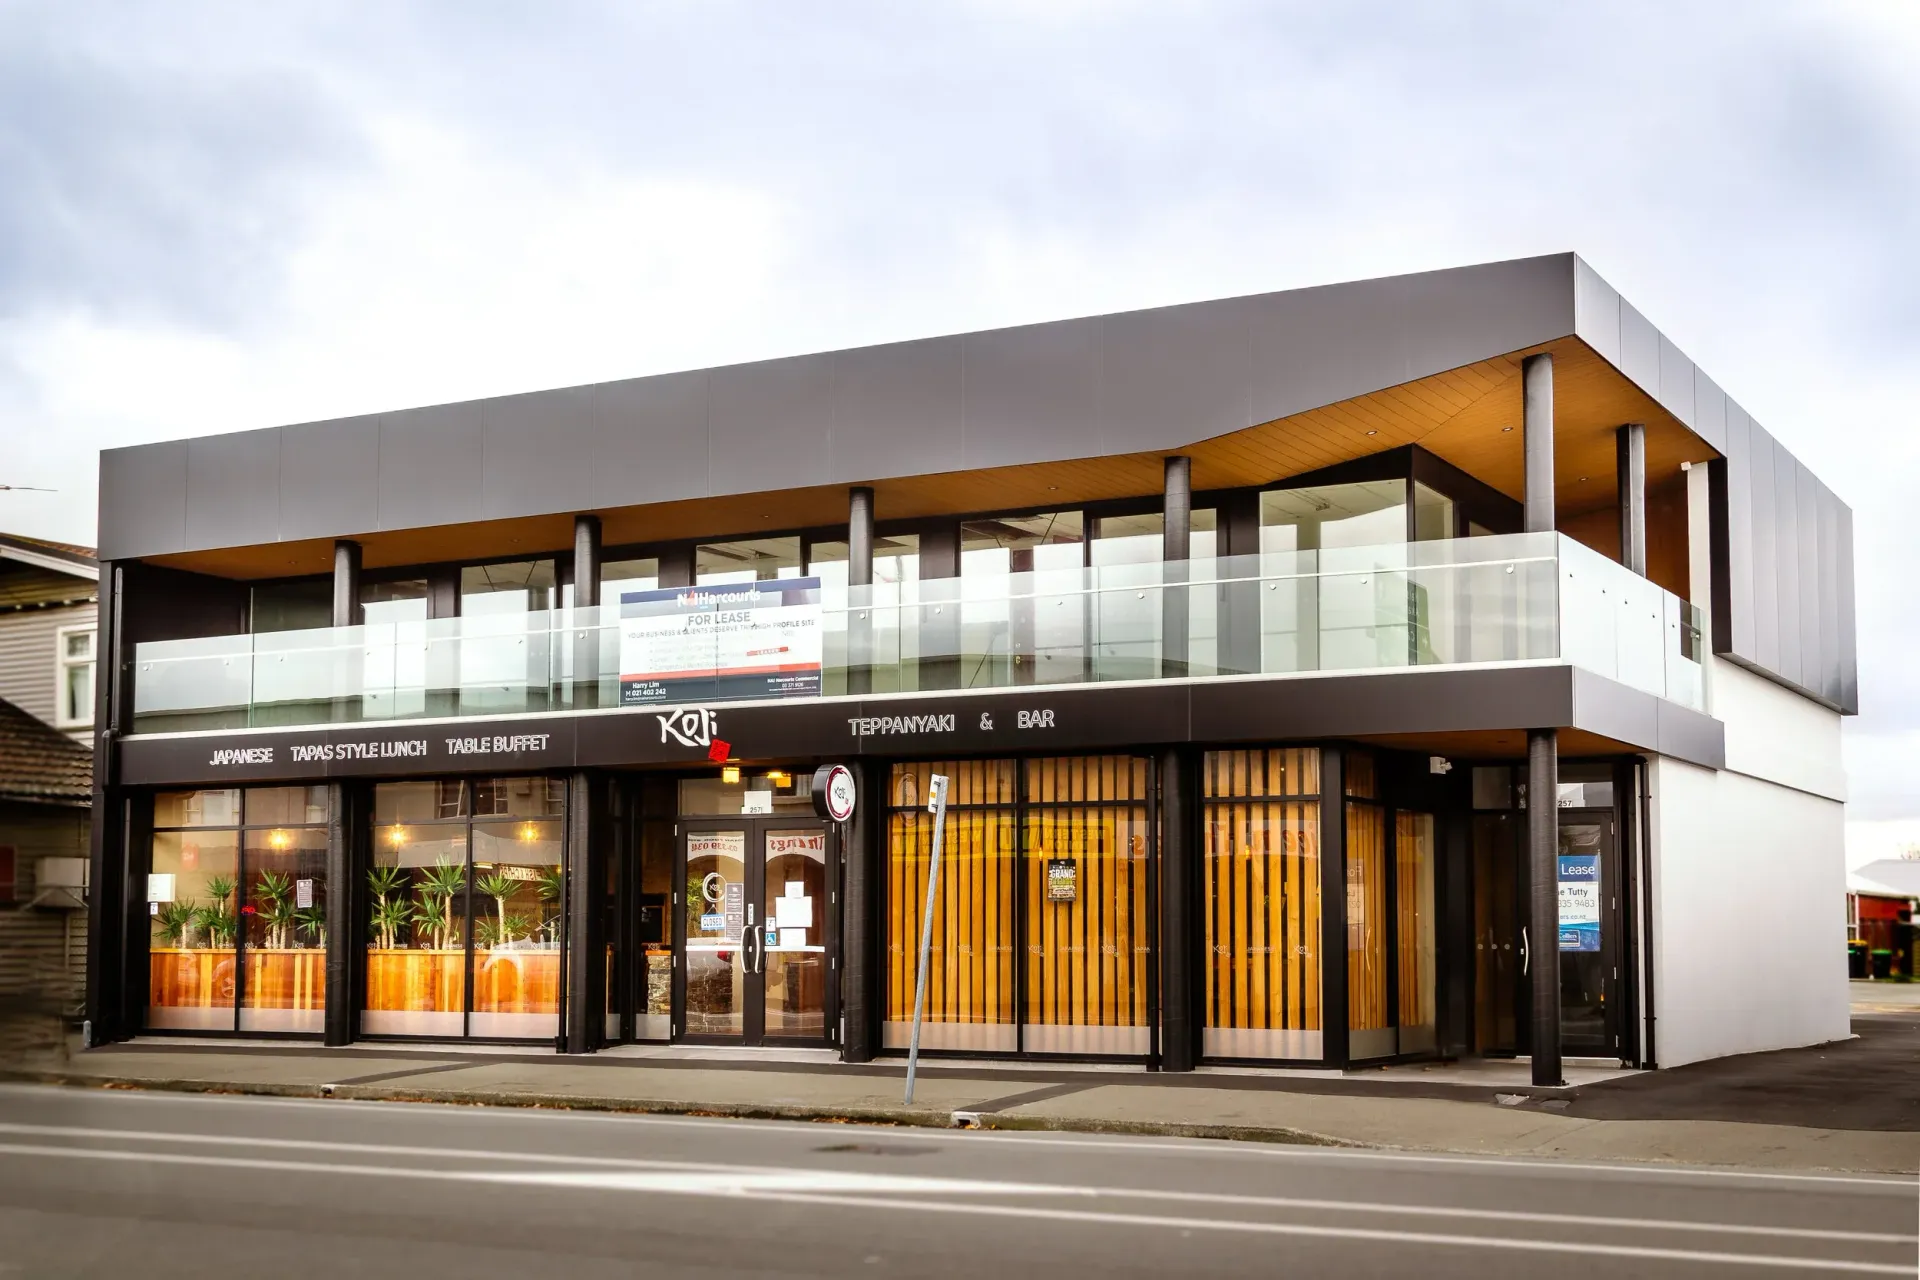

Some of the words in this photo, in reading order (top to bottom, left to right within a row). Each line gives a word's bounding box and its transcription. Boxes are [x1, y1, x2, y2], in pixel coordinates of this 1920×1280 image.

[688, 615, 711, 626] FOR
[715, 612, 751, 624] LEASE
[646, 630, 676, 638] BUSINESS
[773, 620, 800, 628] PROFILE
[802, 619, 815, 627] SITE
[632, 682, 648, 690] Harry
[848, 714, 955, 736] TEPPANYAKI
[979, 712, 993, 731] &
[1017, 709, 1055, 729] BAR
[209, 748, 273, 766] JAPANESE
[290, 745, 333, 762] TAPAS
[335, 742, 378, 760] STYLE
[380, 740, 427, 757] LUNCH
[445, 737, 491, 755] TABLE
[493, 734, 550, 753] BUFFET
[1561, 863, 1595, 875] Lease
[1567, 887, 1588, 898] Tutty
[1574, 899, 1595, 907] 9483
[703, 917, 723, 927] CLOSED
